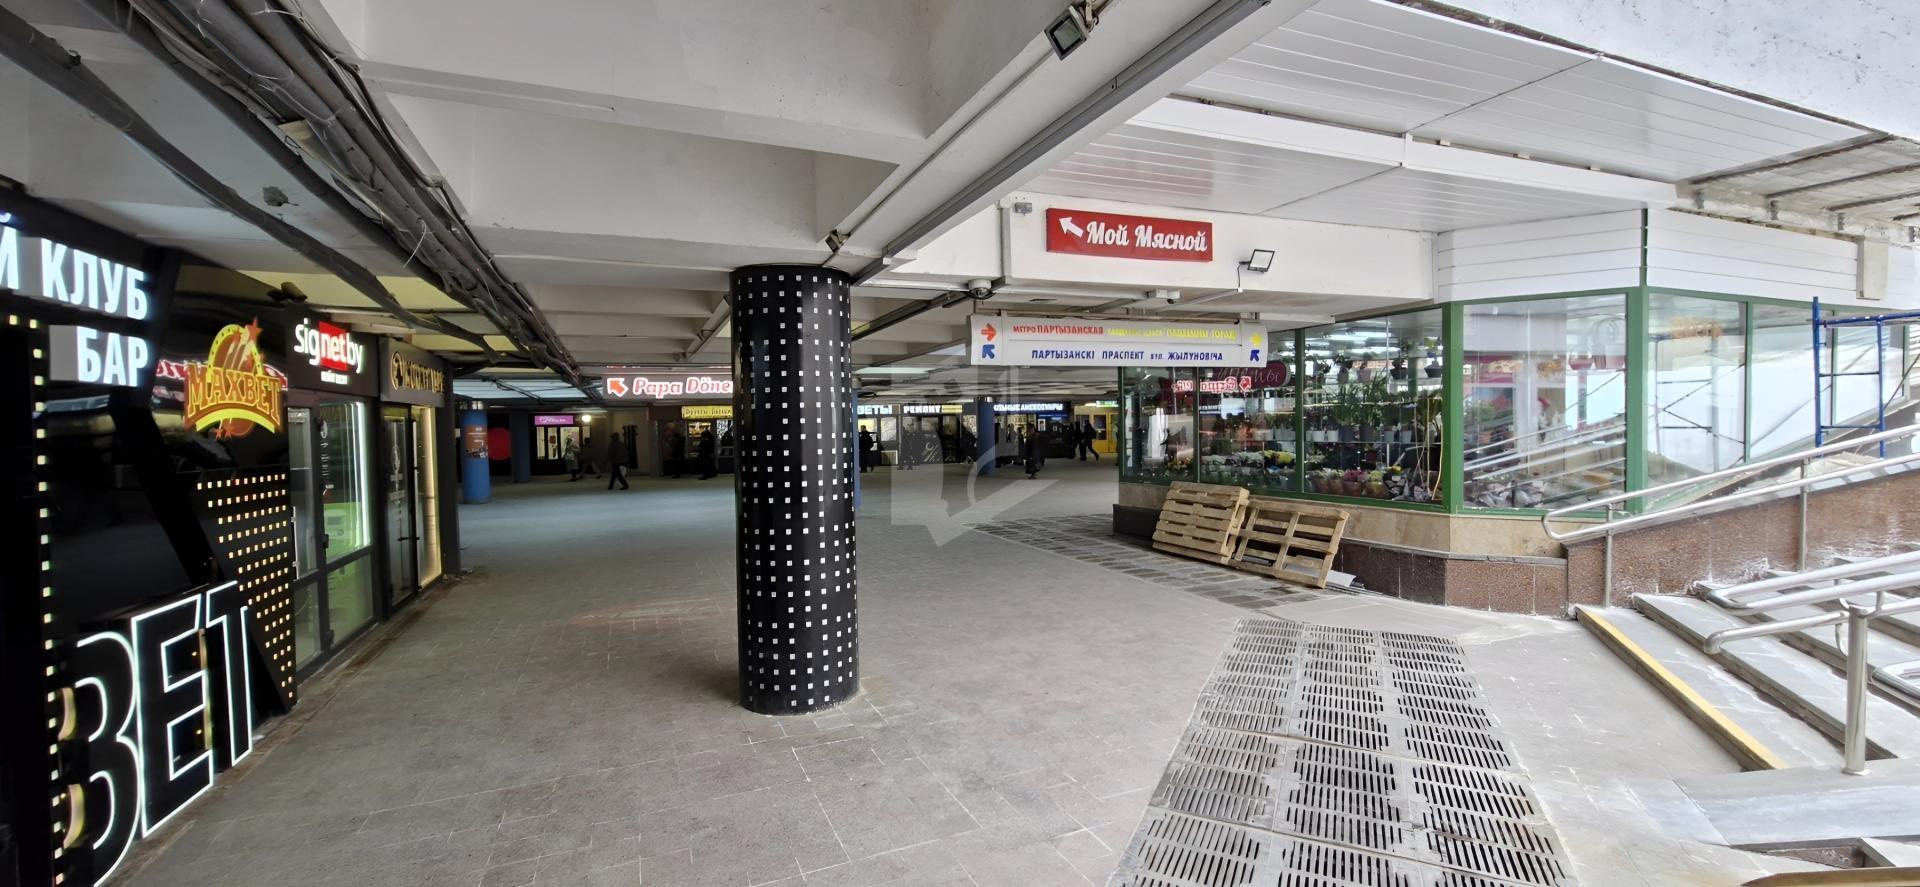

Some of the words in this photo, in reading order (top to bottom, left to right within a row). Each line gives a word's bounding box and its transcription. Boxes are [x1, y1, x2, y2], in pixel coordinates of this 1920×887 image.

[1086, 221, 1130, 246] Мой
[1134, 225, 1208, 253] Мясной
[40, 237, 148, 321] КЛУБ
[1036, 324, 1104, 335] ПАРТЫЗАНСКАЯ
[76, 325, 149, 388] БАР
[1031, 349, 1095, 360] ПАРТЫЗАНСКІ
[1167, 352, 1223, 361] ЖЫЛУНОВІЧА
[186, 362, 281, 428] MAXBET
[633, 376, 683, 398] Papa
[685, 376, 734, 395] Döne
[903, 405, 941, 414] РЕМОНТ
[66, 580, 253, 887] BET
